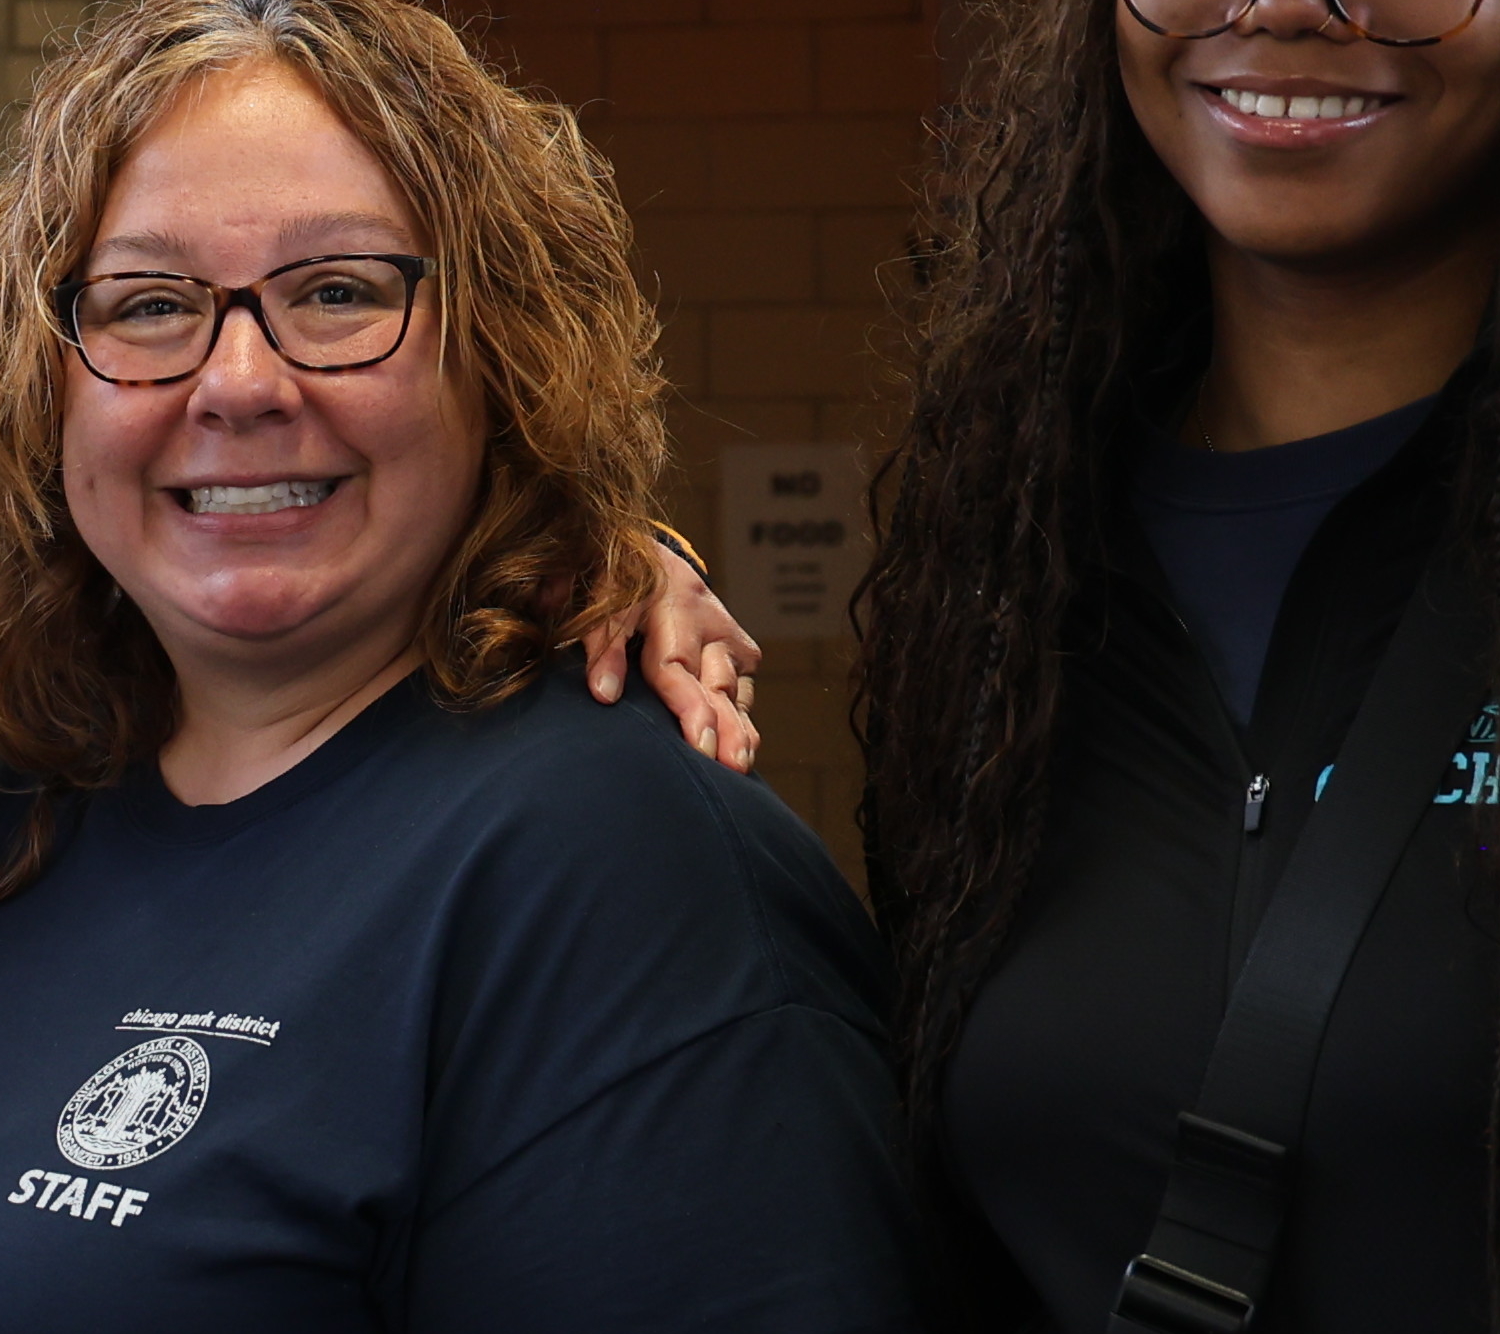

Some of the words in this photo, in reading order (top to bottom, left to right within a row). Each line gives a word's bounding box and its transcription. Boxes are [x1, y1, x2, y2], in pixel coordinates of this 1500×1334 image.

[121, 1008, 179, 1028] chicago
[176, 1011, 216, 1030] park
[215, 1013, 281, 1039] district
[126, 1053, 165, 1071] HORTUS
[138, 1040, 175, 1055] PARK
[179, 1041, 207, 1092] DISTRICT
[67, 1056, 126, 1112] CHICAGO
[163, 1104, 200, 1139] SEAL
[60, 1125, 105, 1165] ORGANIZED
[116, 1147, 148, 1166] 1934
[8, 1169, 149, 1227] STAFF
